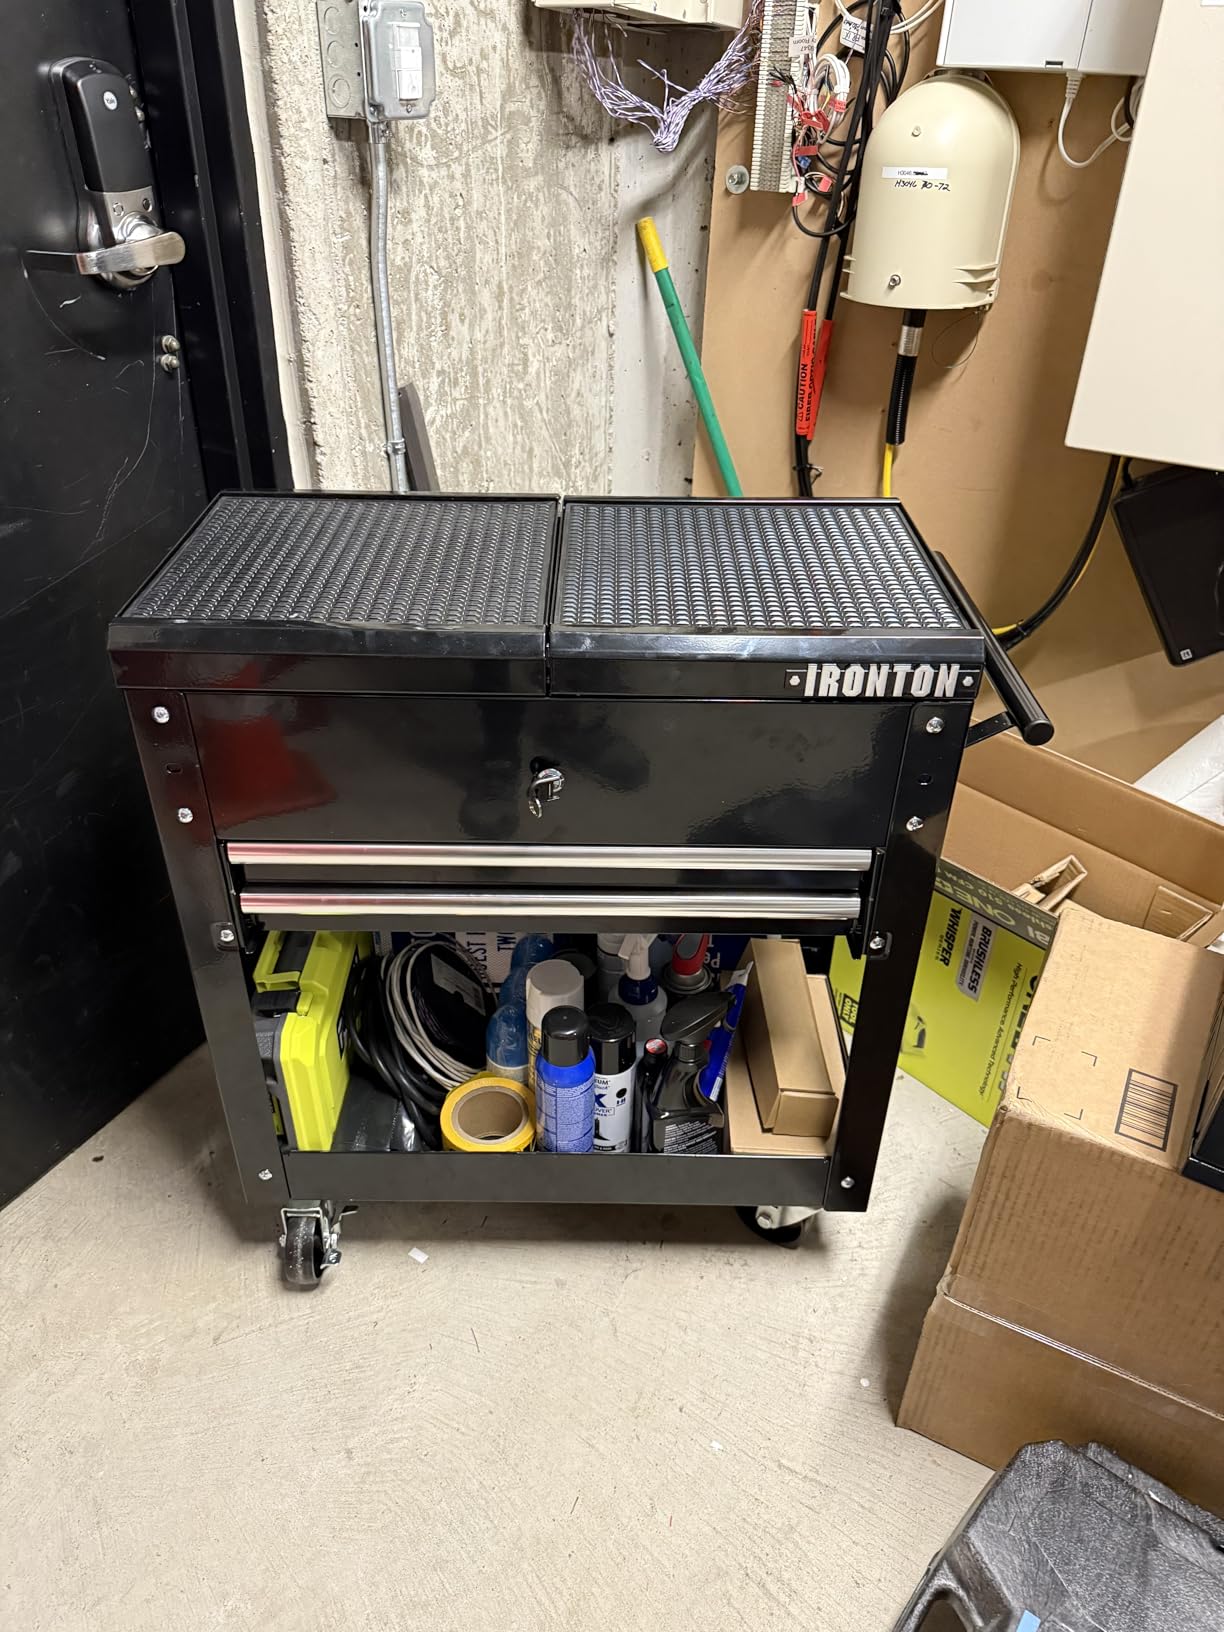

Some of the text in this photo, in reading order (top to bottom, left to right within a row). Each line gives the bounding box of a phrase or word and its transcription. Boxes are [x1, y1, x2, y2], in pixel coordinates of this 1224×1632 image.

[798, 363, 808, 410] CAUTION
[804, 663, 960, 697] IRONTON
[939, 907, 962, 967] WHISPER
[967, 925, 993, 994] BRUSHLESS
[842, 998, 852, 1020] ONLY
[849, 1002, 859, 1025] TOOL
[1000, 979, 1018, 1026] Performance
[989, 1026, 1004, 1060] Advanced
